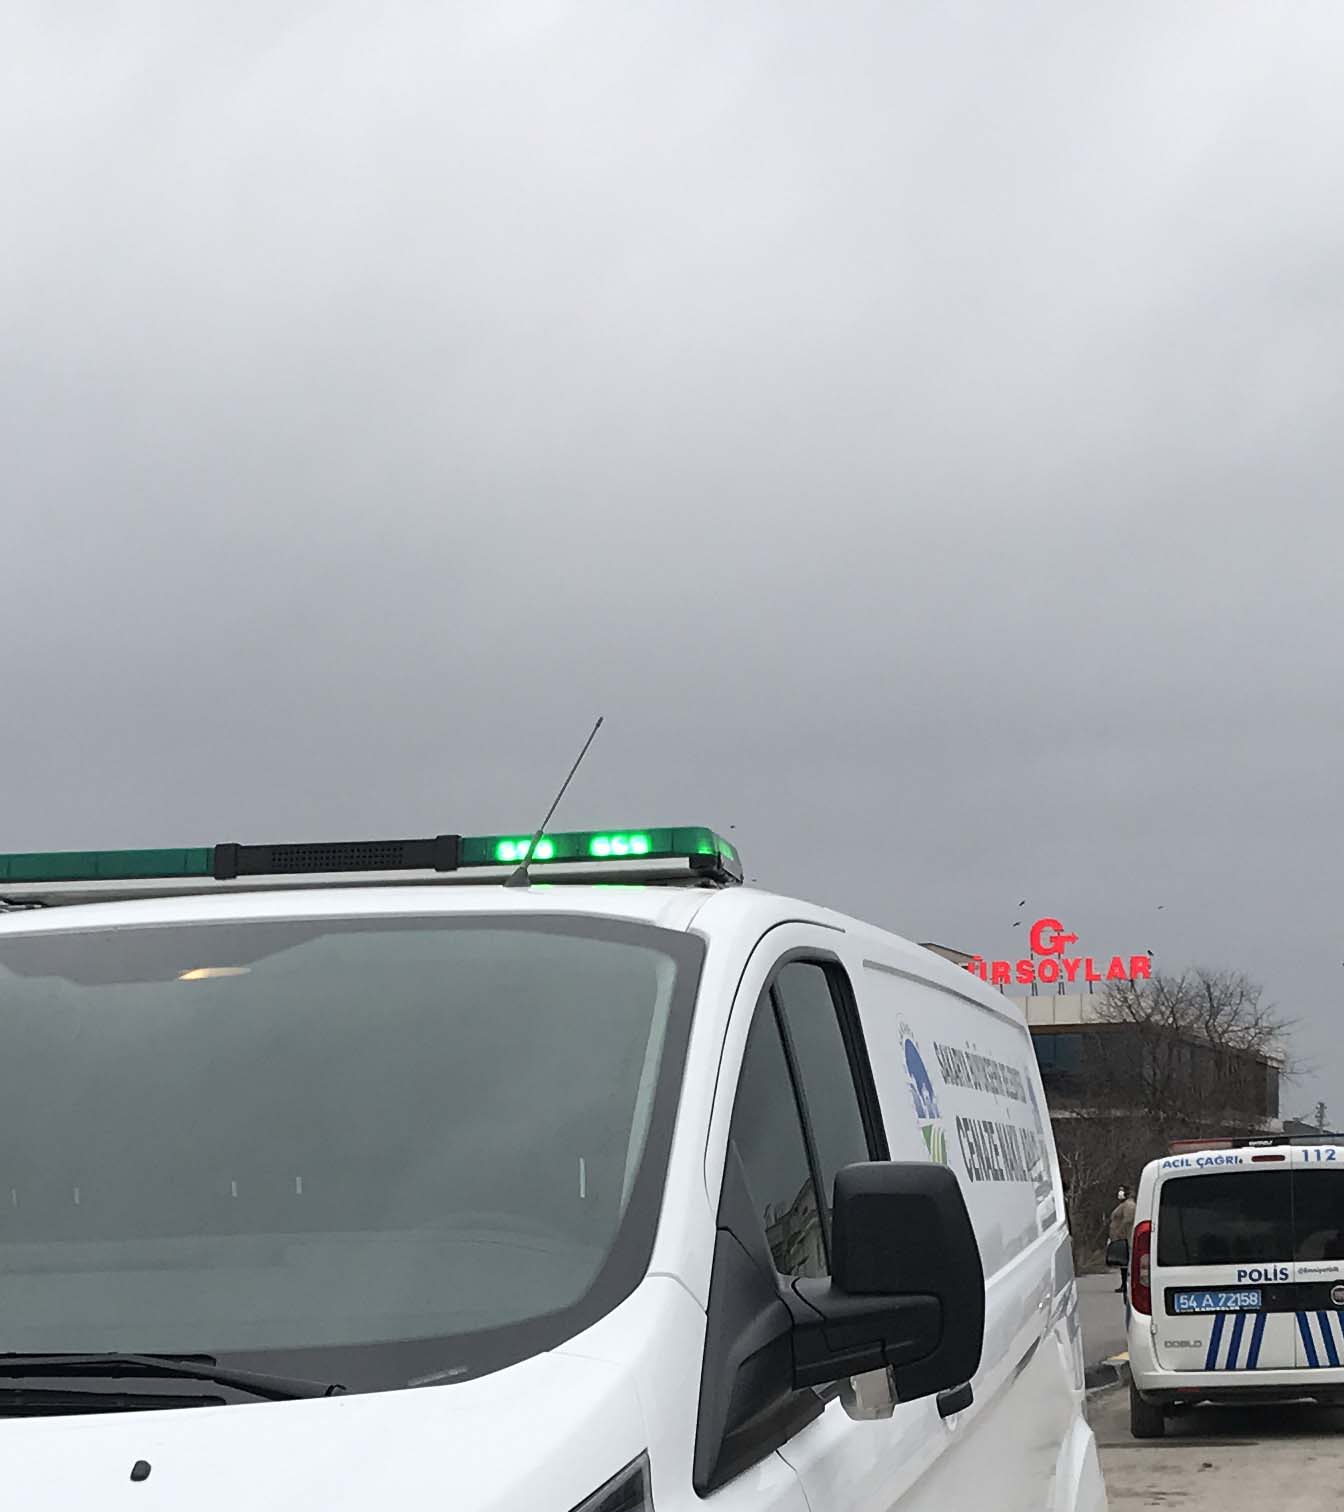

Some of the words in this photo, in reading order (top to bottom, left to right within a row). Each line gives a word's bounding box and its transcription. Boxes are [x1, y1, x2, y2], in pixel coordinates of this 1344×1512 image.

[1162, 1158, 1191, 1169] ACİL
[1197, 1155, 1238, 1169] ÇAĞRI
[1303, 1149, 1336, 1163] 112
[1237, 1264, 1289, 1283] POLİS
[1180, 1295, 1197, 1309] 54
[1202, 1294, 1214, 1307] A
[1218, 1292, 1259, 1306] 72158
